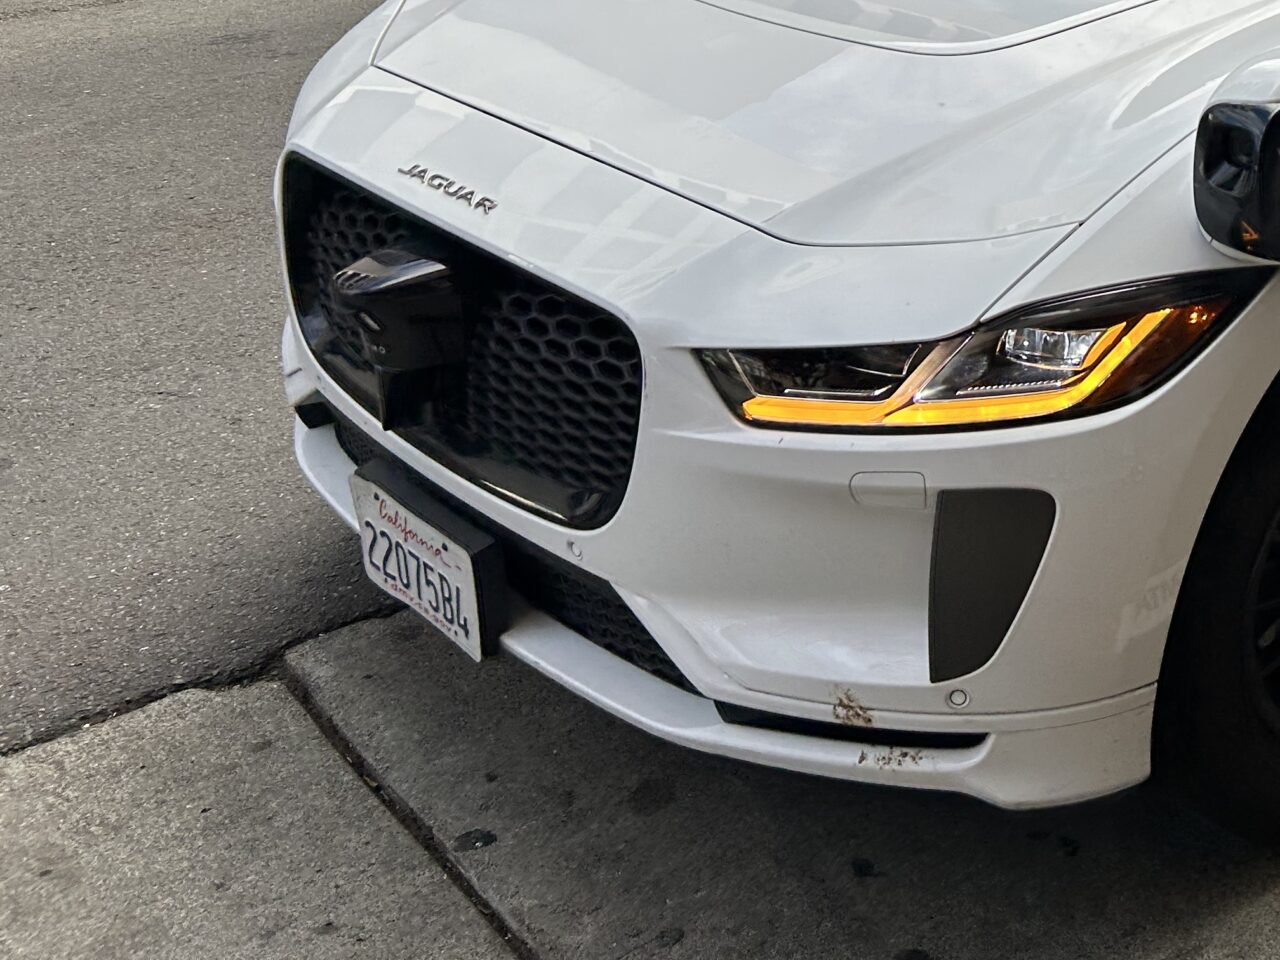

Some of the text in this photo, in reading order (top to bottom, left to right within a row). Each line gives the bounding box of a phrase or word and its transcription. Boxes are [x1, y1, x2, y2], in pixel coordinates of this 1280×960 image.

[398, 164, 498, 215] JAGUAR
[379, 499, 452, 568] California
[365, 520, 469, 640] 22075B4
